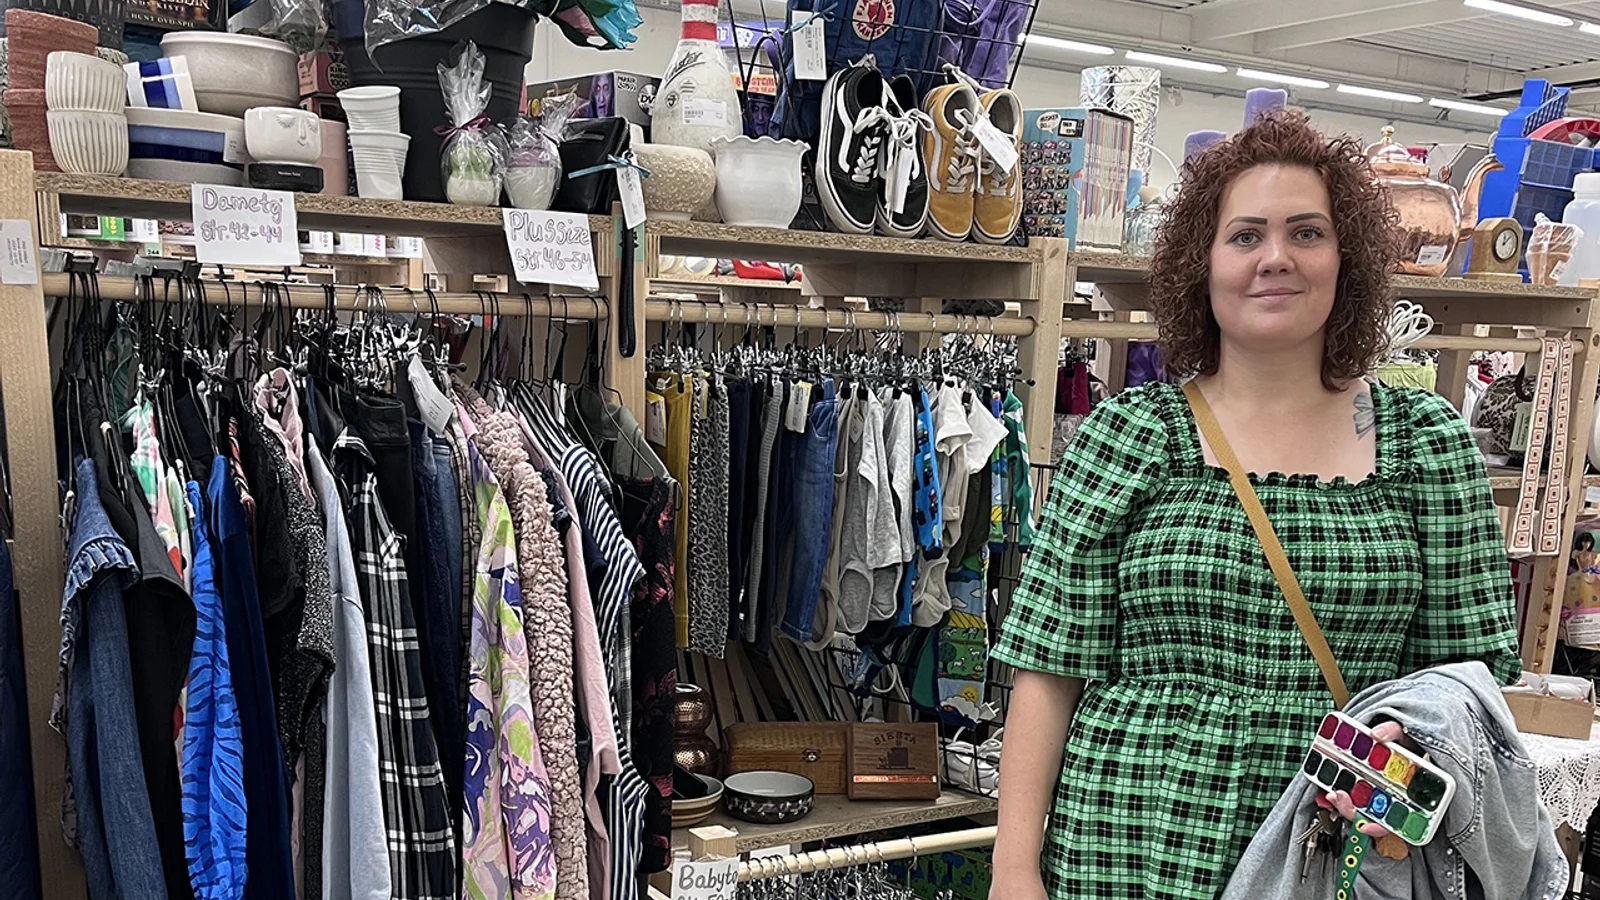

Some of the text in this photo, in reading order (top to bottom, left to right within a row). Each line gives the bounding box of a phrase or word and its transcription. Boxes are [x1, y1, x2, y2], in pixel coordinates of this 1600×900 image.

[131, 12, 155, 22] HUNT
[330, 66, 348, 74] KING
[331, 79, 349, 88] 1000
[640, 94, 656, 104] DV
[873, 731, 917, 746] SIESTA
